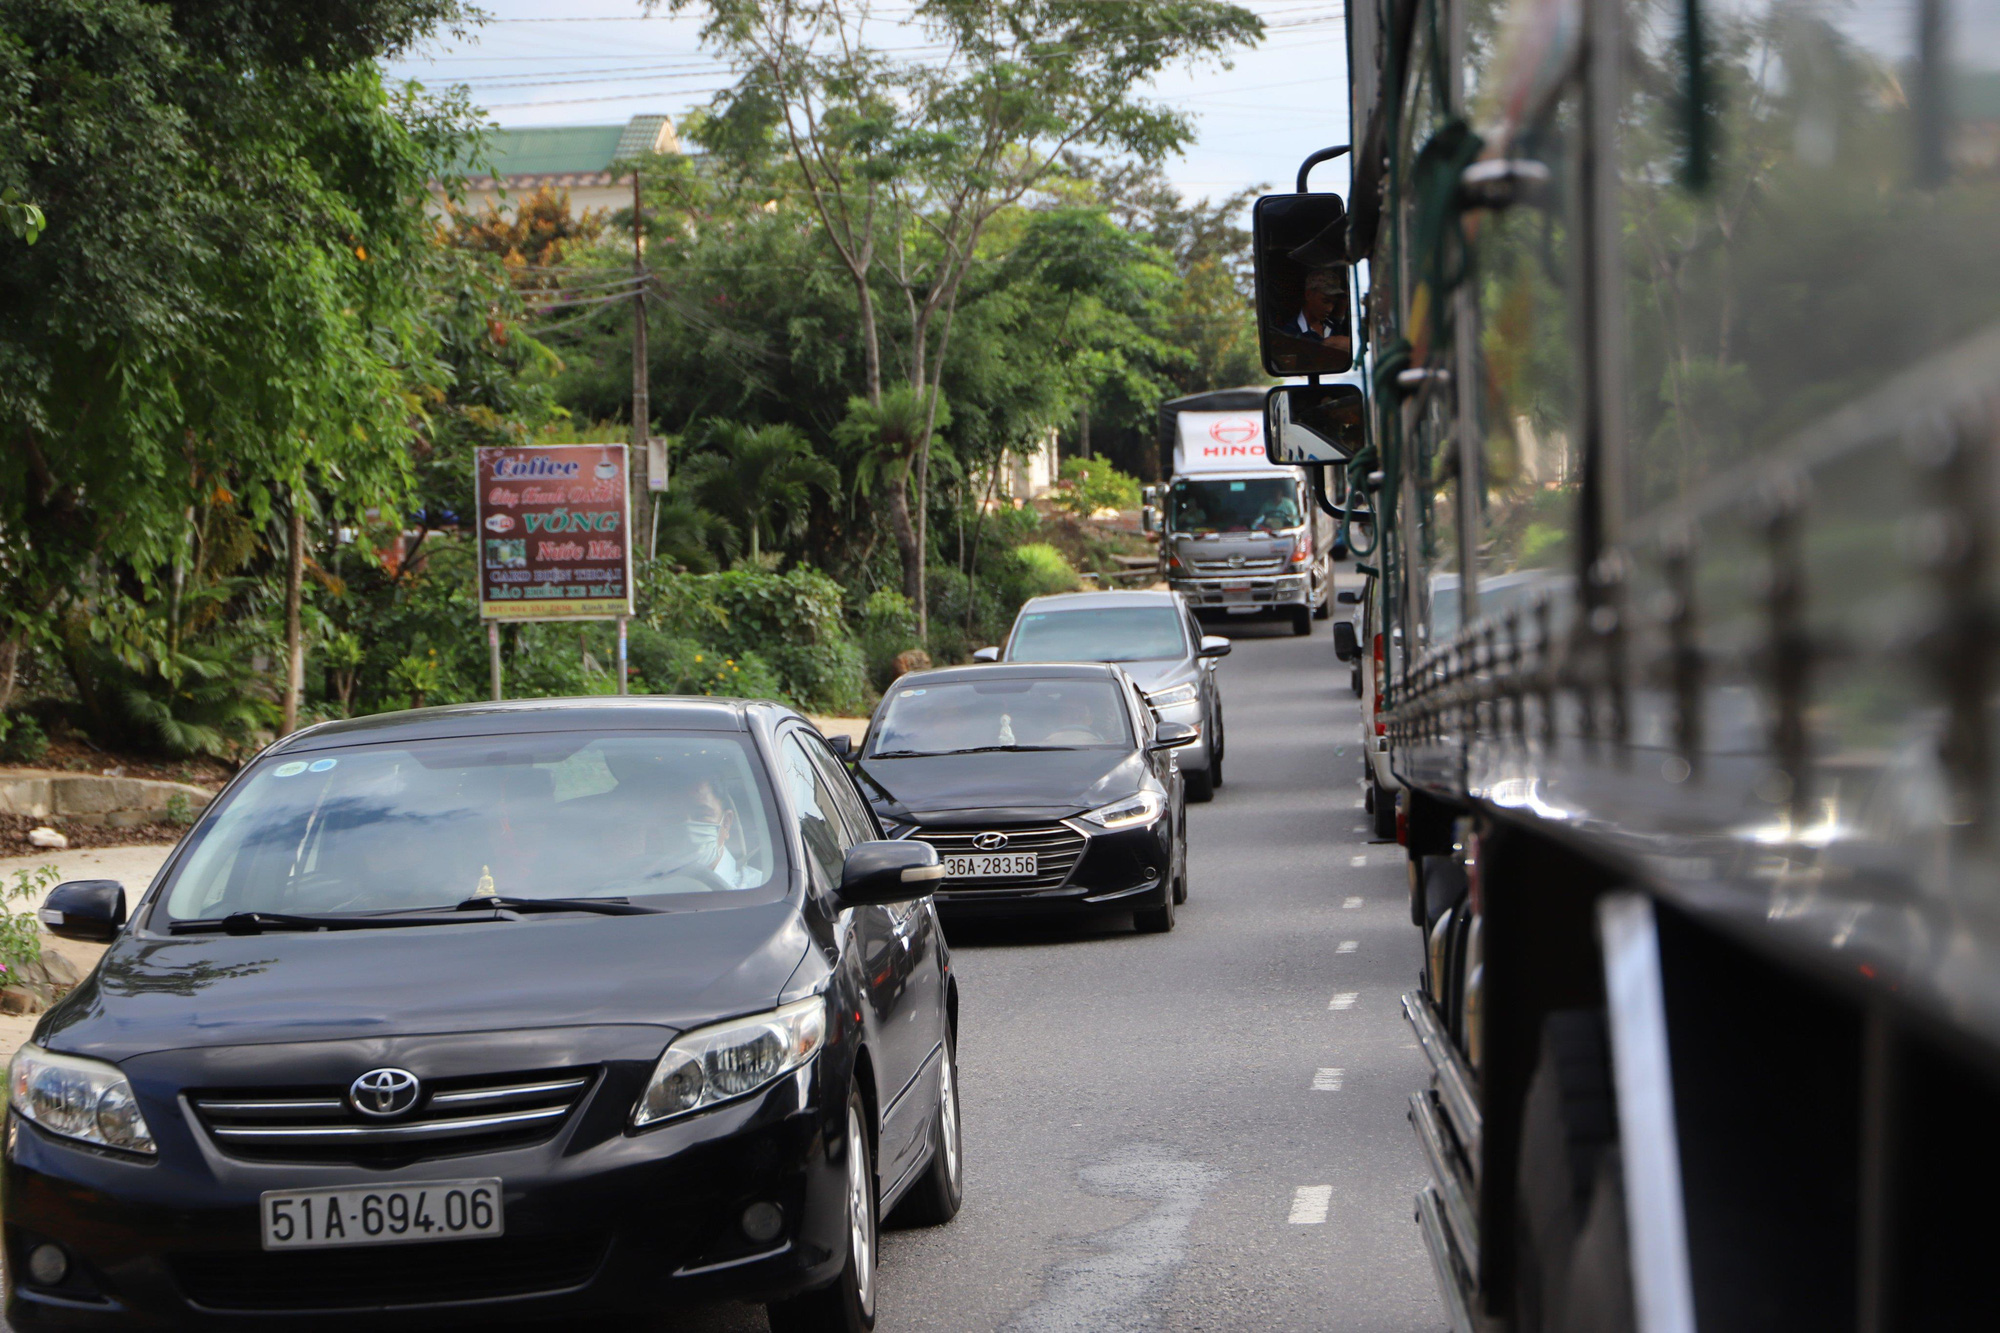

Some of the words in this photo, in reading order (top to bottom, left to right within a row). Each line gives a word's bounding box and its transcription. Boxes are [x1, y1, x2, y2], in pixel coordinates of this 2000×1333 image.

[1203, 446, 1265, 457] HINO
[493, 455, 579, 477] Coffee
[522, 508, 620, 533] VÕNG
[536, 541, 584, 561] Nước
[586, 540, 622, 560] Mía
[489, 569, 532, 582] CARD
[534, 567, 572, 584] ĐIỆN
[575, 568, 622, 583] THOẠI
[489, 584, 522, 599] BẢO
[524, 582, 565, 598] HIỂM
[566, 586, 587, 598] XE
[589, 583, 623, 597] MÁY
[947, 856, 1034, 875] 36A-283.56
[271, 1188, 493, 1241] 51A-694.06
